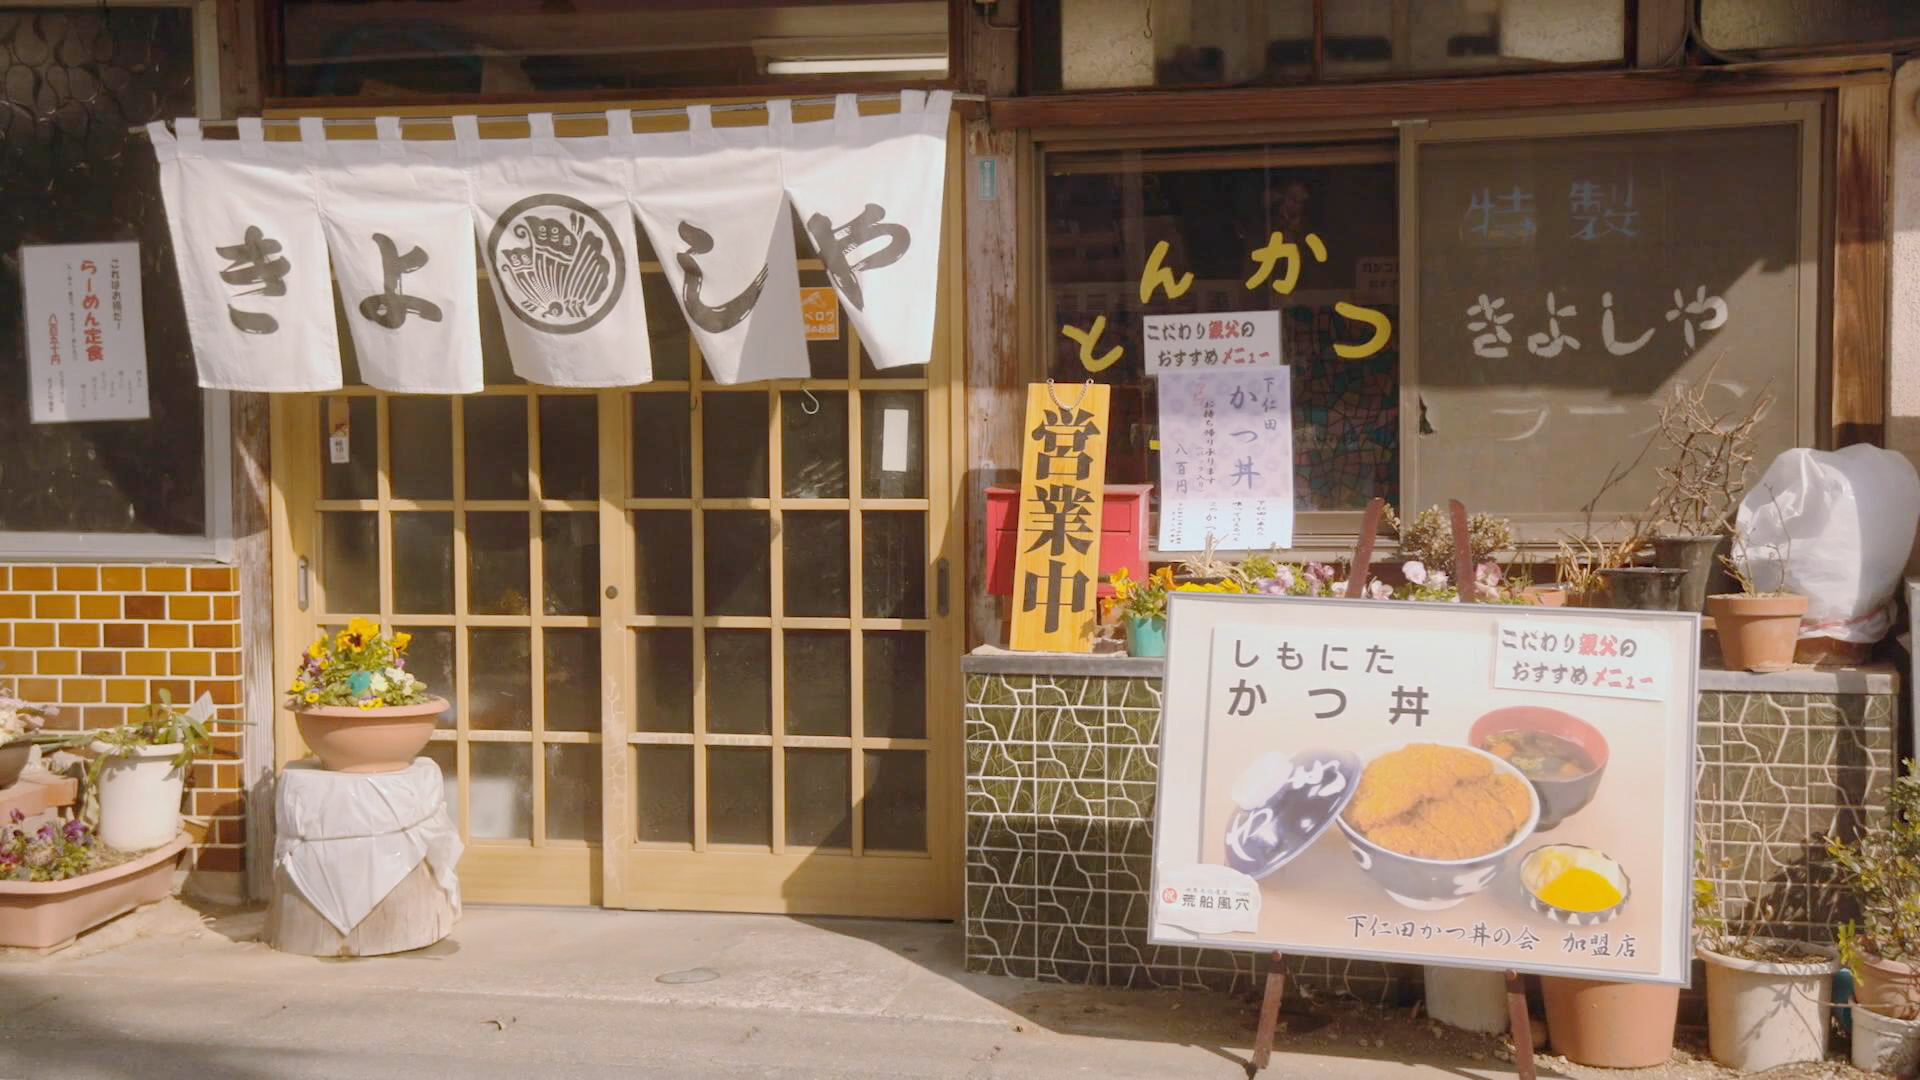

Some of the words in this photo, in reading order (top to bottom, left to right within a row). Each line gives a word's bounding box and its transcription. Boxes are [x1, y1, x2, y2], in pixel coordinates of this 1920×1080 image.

[80, 259, 104, 362] らーめん定食
[1147, 320, 1255, 341] こだわり親父の
[1467, 285, 1728, 358] きよしや
[1158, 347, 1270, 367] おすすめメニュー
[1262, 377, 1277, 431] 下仁田
[1229, 385, 1261, 490] かつ丼
[1175, 443, 1188, 494] 八百円
[1023, 408, 1101, 634] 営業中
[1235, 639, 1394, 674] しもにた
[1502, 629, 1637, 658] こだわり親父の
[1512, 661, 1654, 690] おすすめメニュー
[1227, 679, 1429, 727] かつ丼
[1182, 894, 1249, 911] 荒船風穴
[1347, 914, 1541, 951] 下仁田かつ丼の会
[1562, 932, 1636, 958] 加盟店
